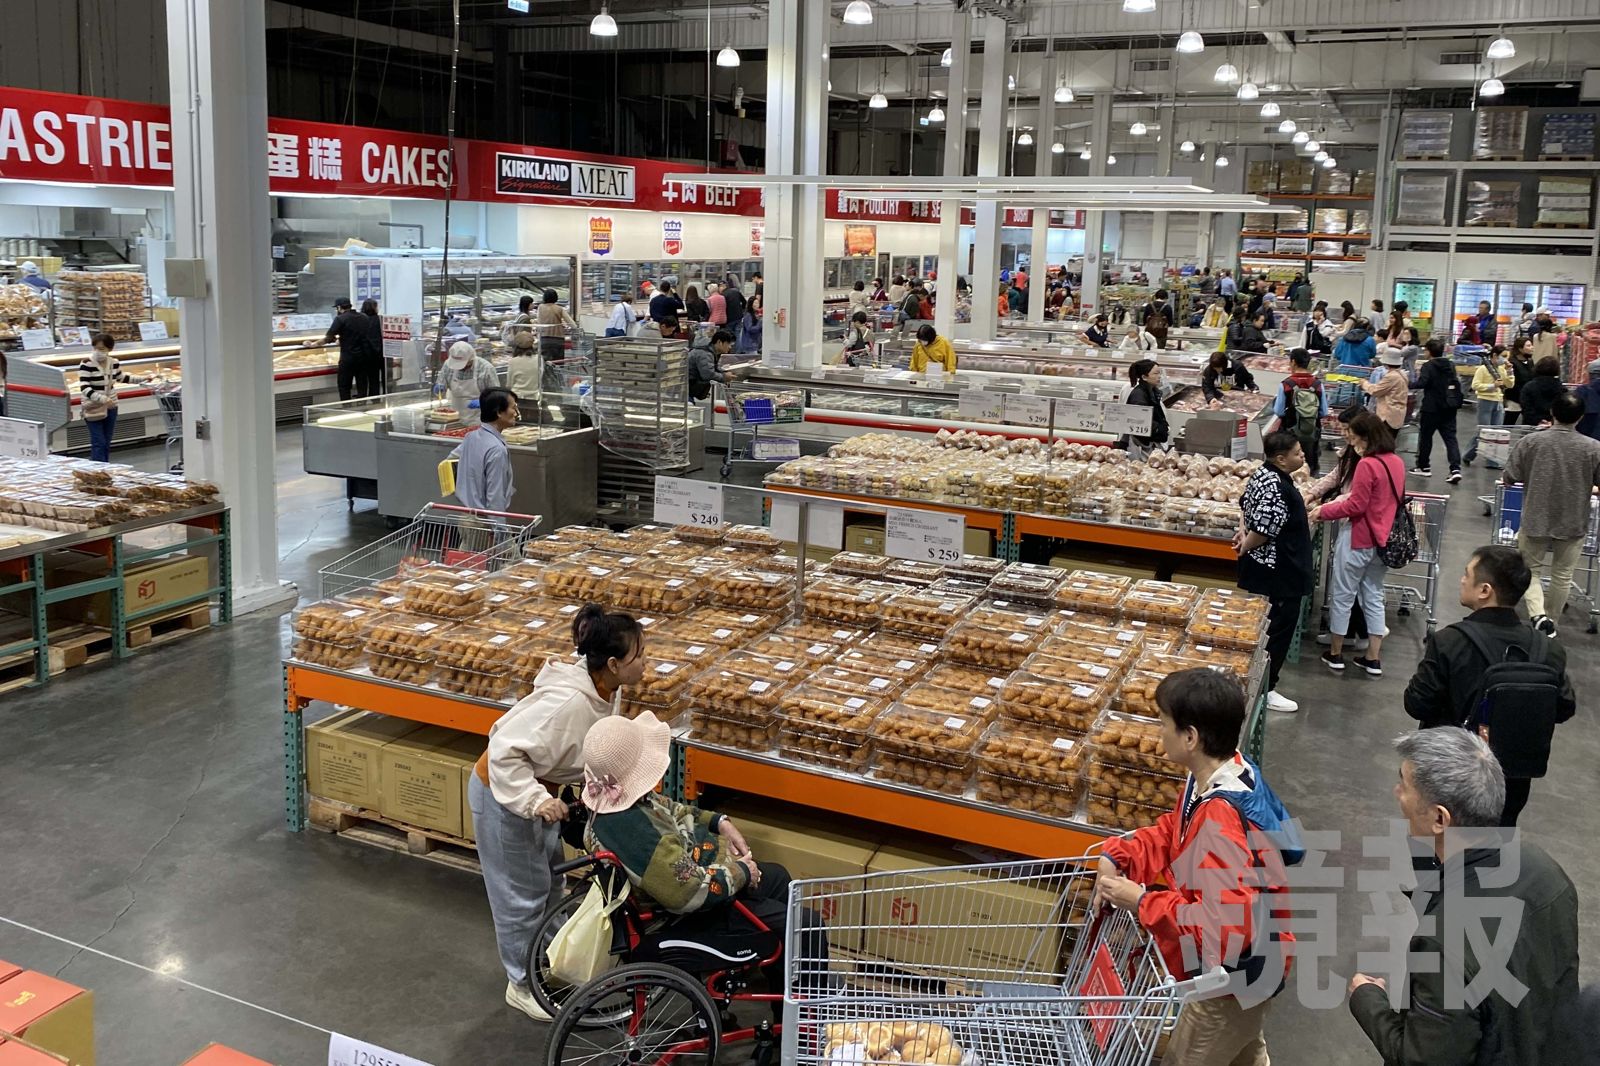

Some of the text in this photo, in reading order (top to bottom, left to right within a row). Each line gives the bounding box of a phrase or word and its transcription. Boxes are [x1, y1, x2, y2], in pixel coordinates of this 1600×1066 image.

[268, 133, 342, 181] 蛋糕
[361, 141, 453, 188] CAKES
[501, 159, 570, 181] KIRKLAND
[501, 178, 569, 192] Signature
[577, 166, 628, 196] MEAT
[705, 185, 740, 207] BEEF
[863, 199, 900, 215] POULTRY
[593, 241, 609, 250] BEEF
[700, 514, 719, 526] 249
[938, 549, 960, 561] 259
[736, 948, 752, 956] soma
